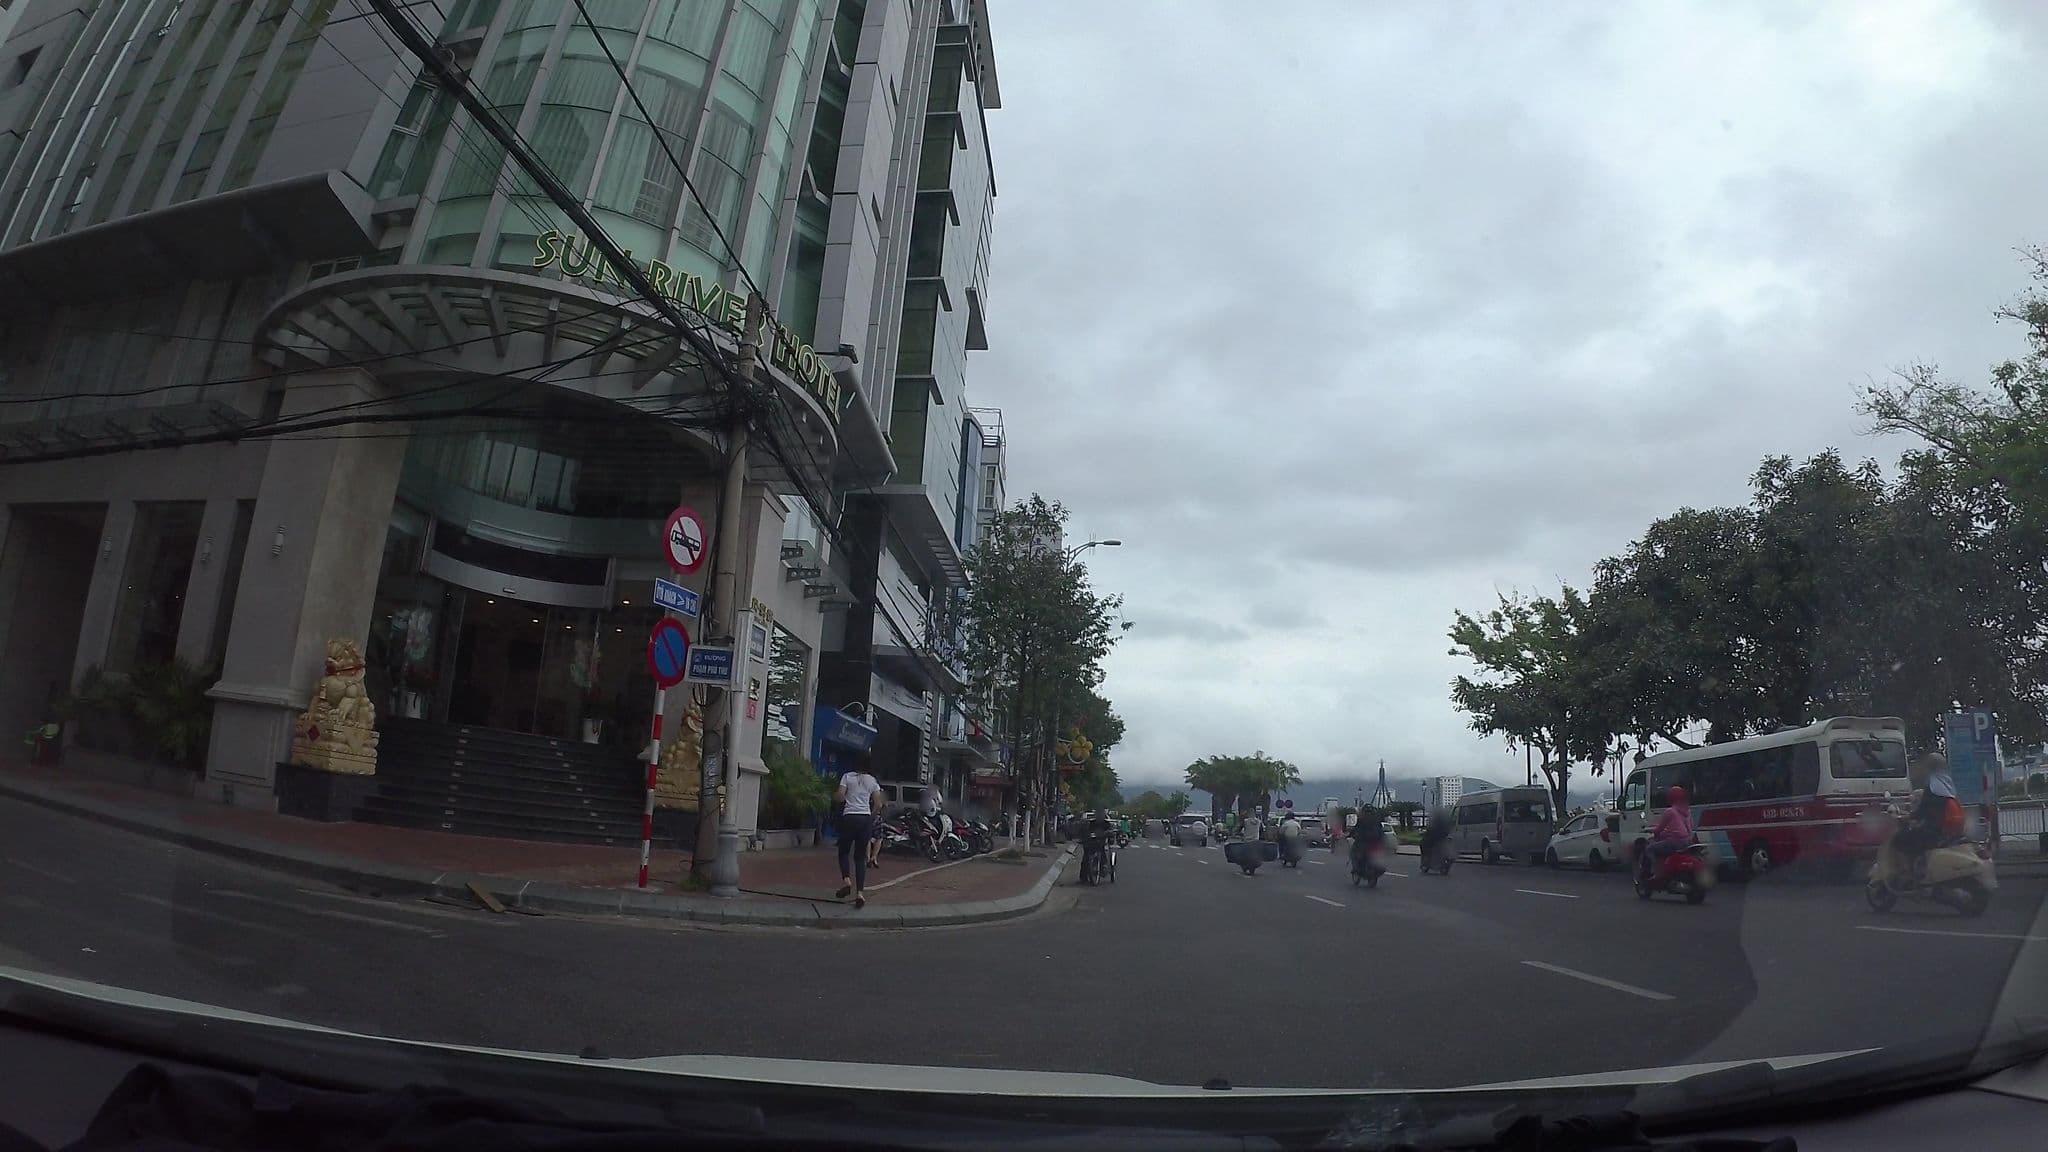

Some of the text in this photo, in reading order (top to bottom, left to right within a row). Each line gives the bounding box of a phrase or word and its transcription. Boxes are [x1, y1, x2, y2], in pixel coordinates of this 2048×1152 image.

[534, 229, 635, 288] SUN
[774, 323, 842, 425] HOTEL
[1974, 714, 1988, 741] P
